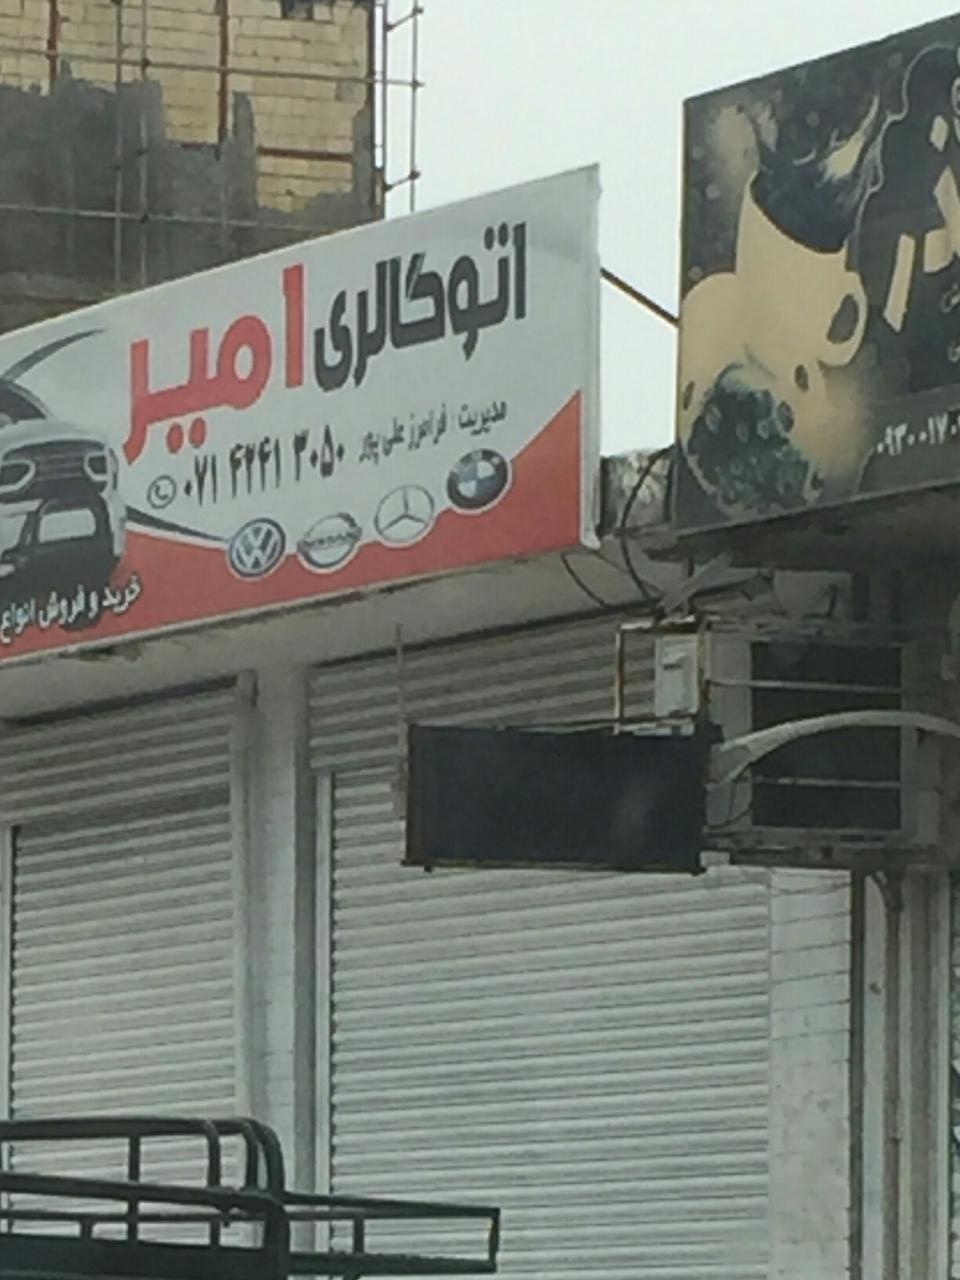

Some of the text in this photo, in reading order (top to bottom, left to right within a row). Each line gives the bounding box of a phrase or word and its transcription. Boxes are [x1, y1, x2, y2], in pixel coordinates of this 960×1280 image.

[123, 262, 304, 465] امیر
[184, 454, 217, 507] ۰۷۱
[39, 584, 86, 628] فروش
[102, 575, 141, 612] خرید
[0, 597, 36, 644] انواع
